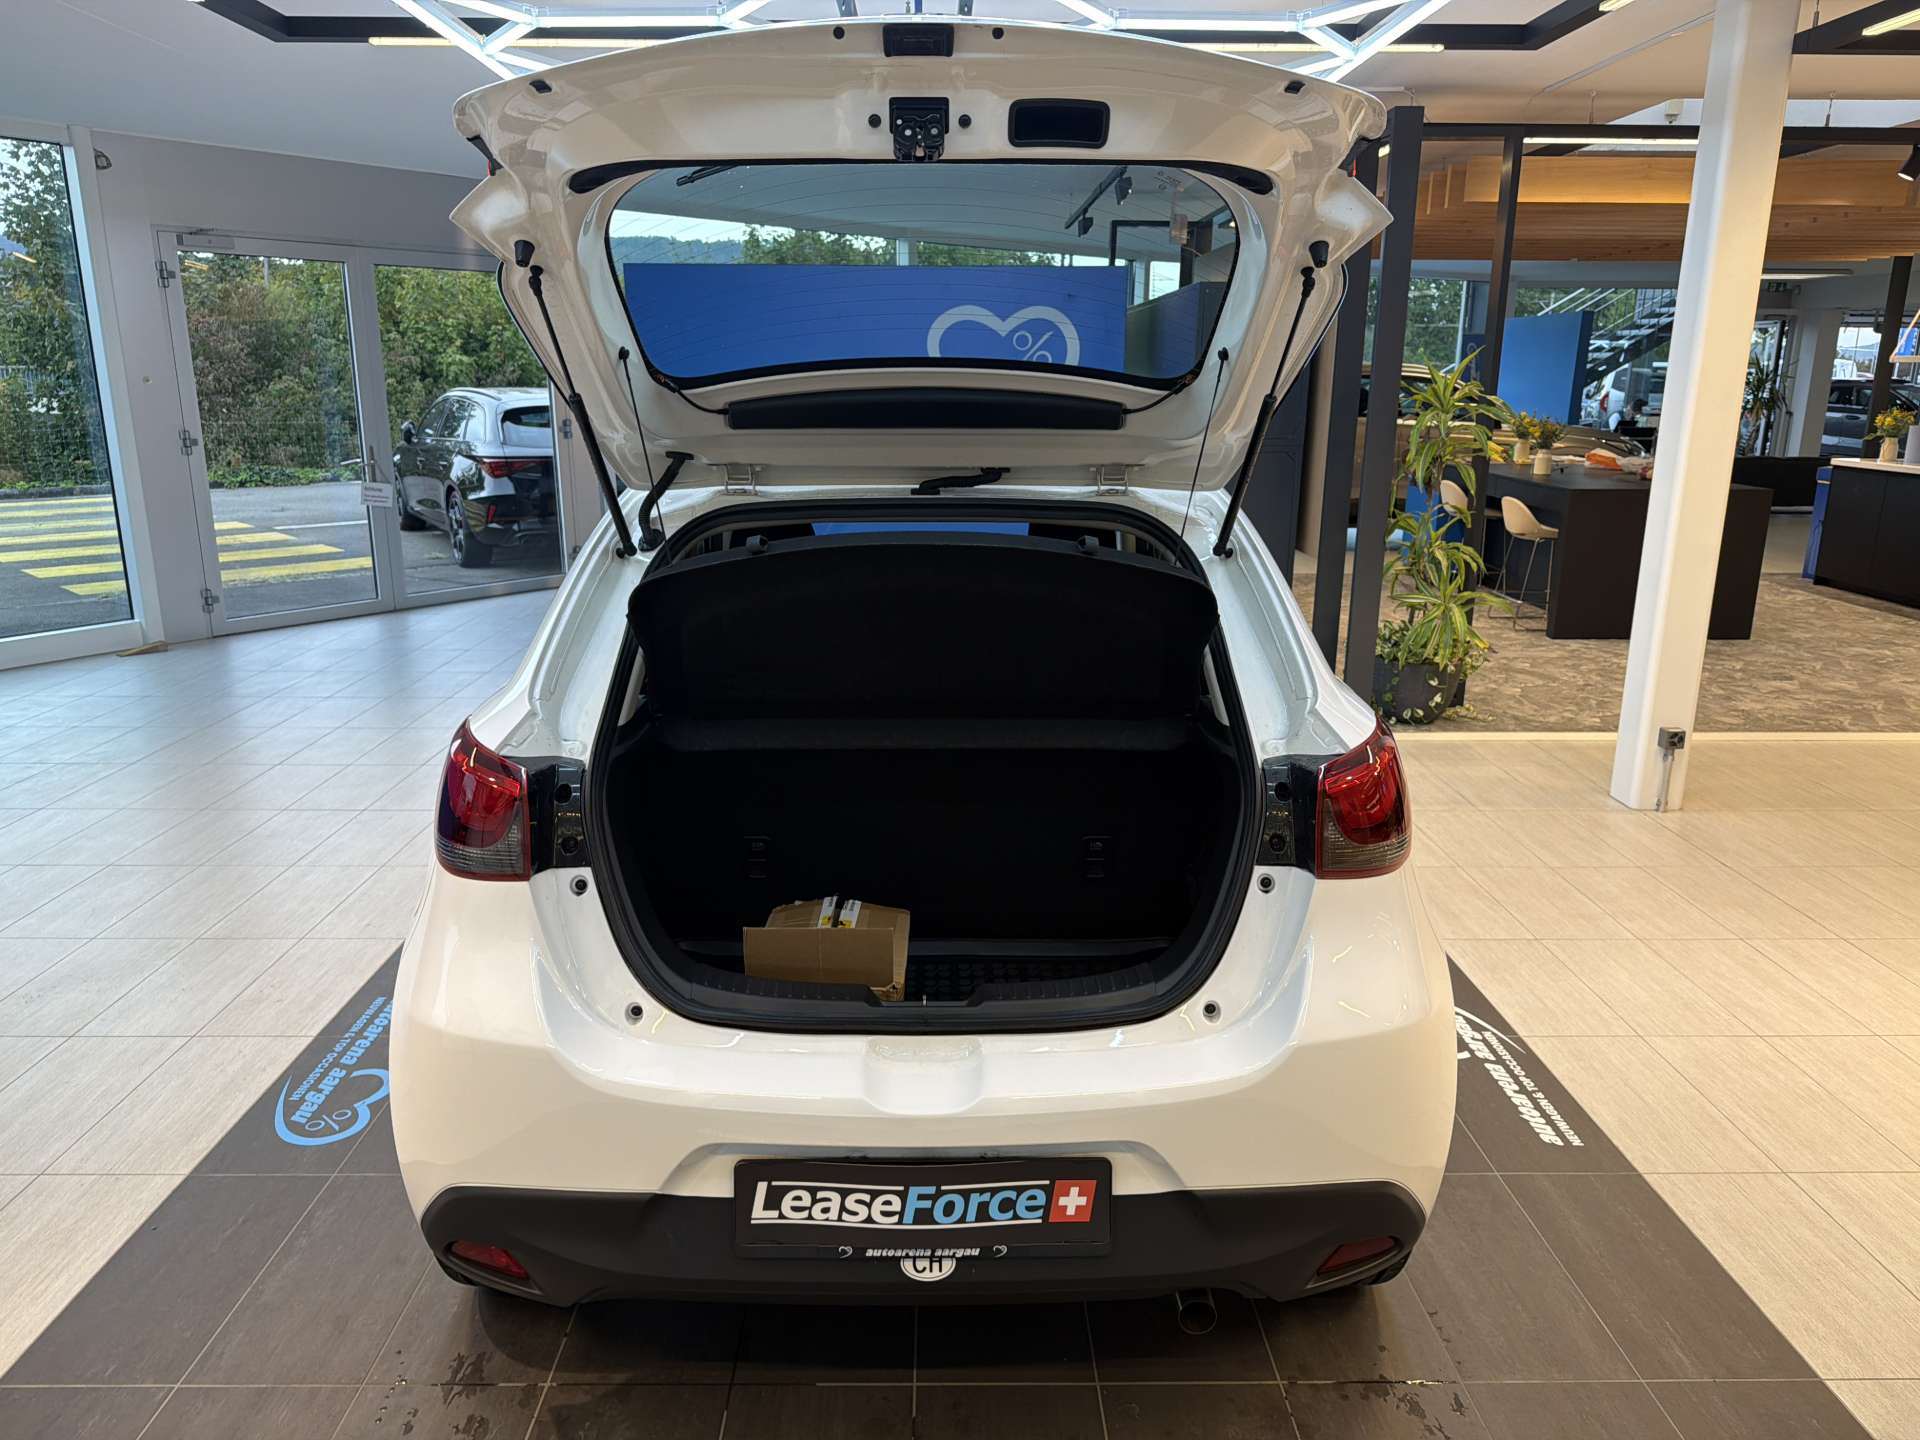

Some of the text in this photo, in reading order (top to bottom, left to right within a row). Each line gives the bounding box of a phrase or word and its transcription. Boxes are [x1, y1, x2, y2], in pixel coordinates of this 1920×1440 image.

[290, 1001, 392, 1123] toarena aargau
[1519, 1076, 1539, 1091] TOP
[1532, 1091, 1545, 1099] &
[1484, 1062, 1565, 1146] autoarena
[1537, 1099, 1584, 1146] NEUWAGEN
[751, 1180, 1047, 1226] LeaseForce
[865, 1247, 981, 1258] autoarena aargau
[912, 1257, 943, 1274] CH
